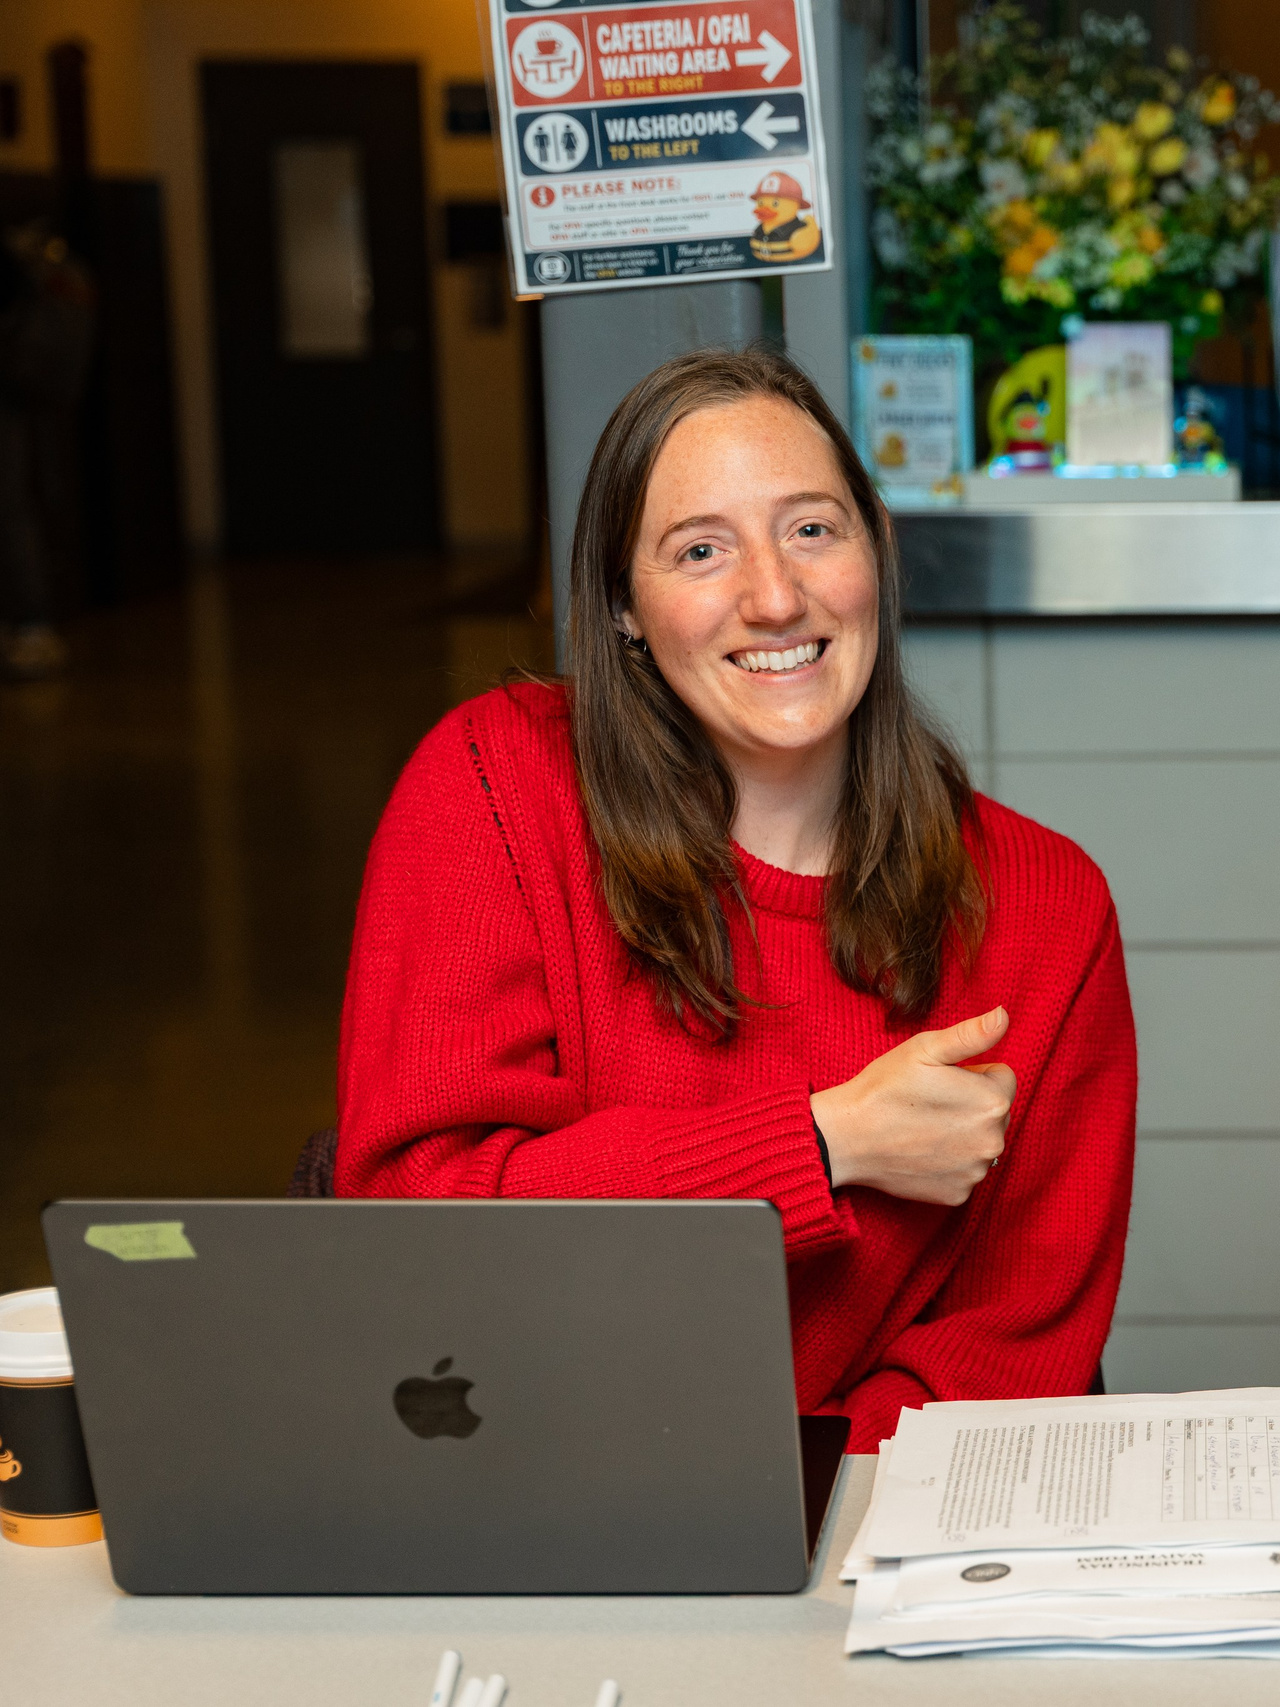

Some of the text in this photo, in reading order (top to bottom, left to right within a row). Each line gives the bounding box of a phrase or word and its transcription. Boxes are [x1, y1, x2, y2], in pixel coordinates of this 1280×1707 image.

[597, 19, 695, 54] CAFETERIA
[708, 13, 751, 44] OFAI
[599, 48, 732, 81] WAITING AREA
[604, 76, 704, 96] TO THE RIGHT
[604, 110, 739, 143] WASHROOMS
[609, 140, 700, 161] TO THE LEFT
[561, 176, 681, 199] PLEASE NOTE:
[1076, 1552, 1204, 1564] WAIVER FORM
[1076, 1559, 1205, 1571] TRAINING DAY
